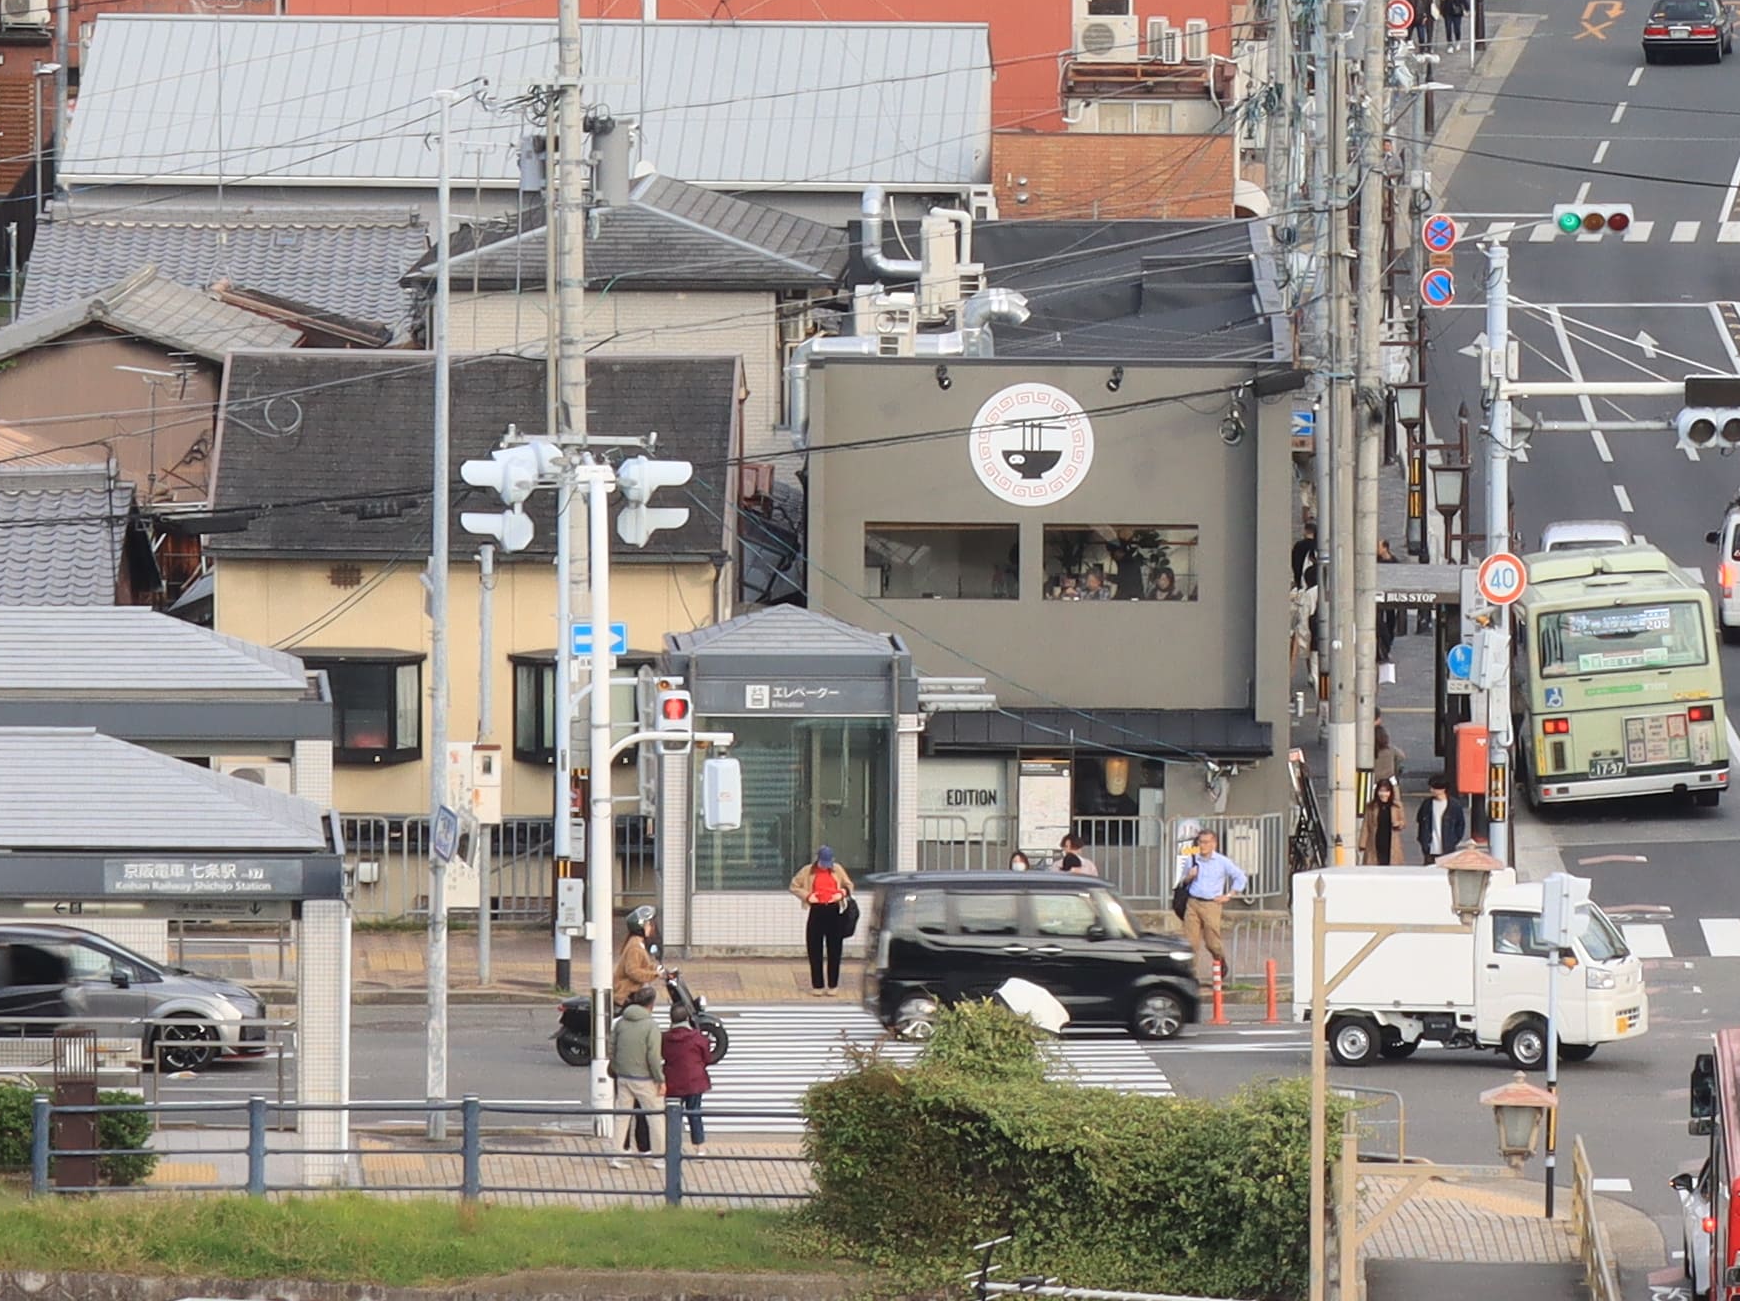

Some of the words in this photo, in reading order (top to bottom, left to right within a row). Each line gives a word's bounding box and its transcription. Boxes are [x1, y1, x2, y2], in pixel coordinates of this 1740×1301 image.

[1490, 568, 1515, 589] 40
[1386, 593, 1408, 603] BUS
[1409, 593, 1437, 603] STOP
[772, 687, 840, 699] エレベーター
[946, 789, 997, 806] EDITION
[123, 863, 185, 879] 京阪電車
[190, 863, 236, 879] 七条駅
[115, 881, 150, 891] Keihan
[152, 881, 192, 893] Railway
[194, 881, 234, 893] Shichijo
[236, 882, 272, 891] Station
